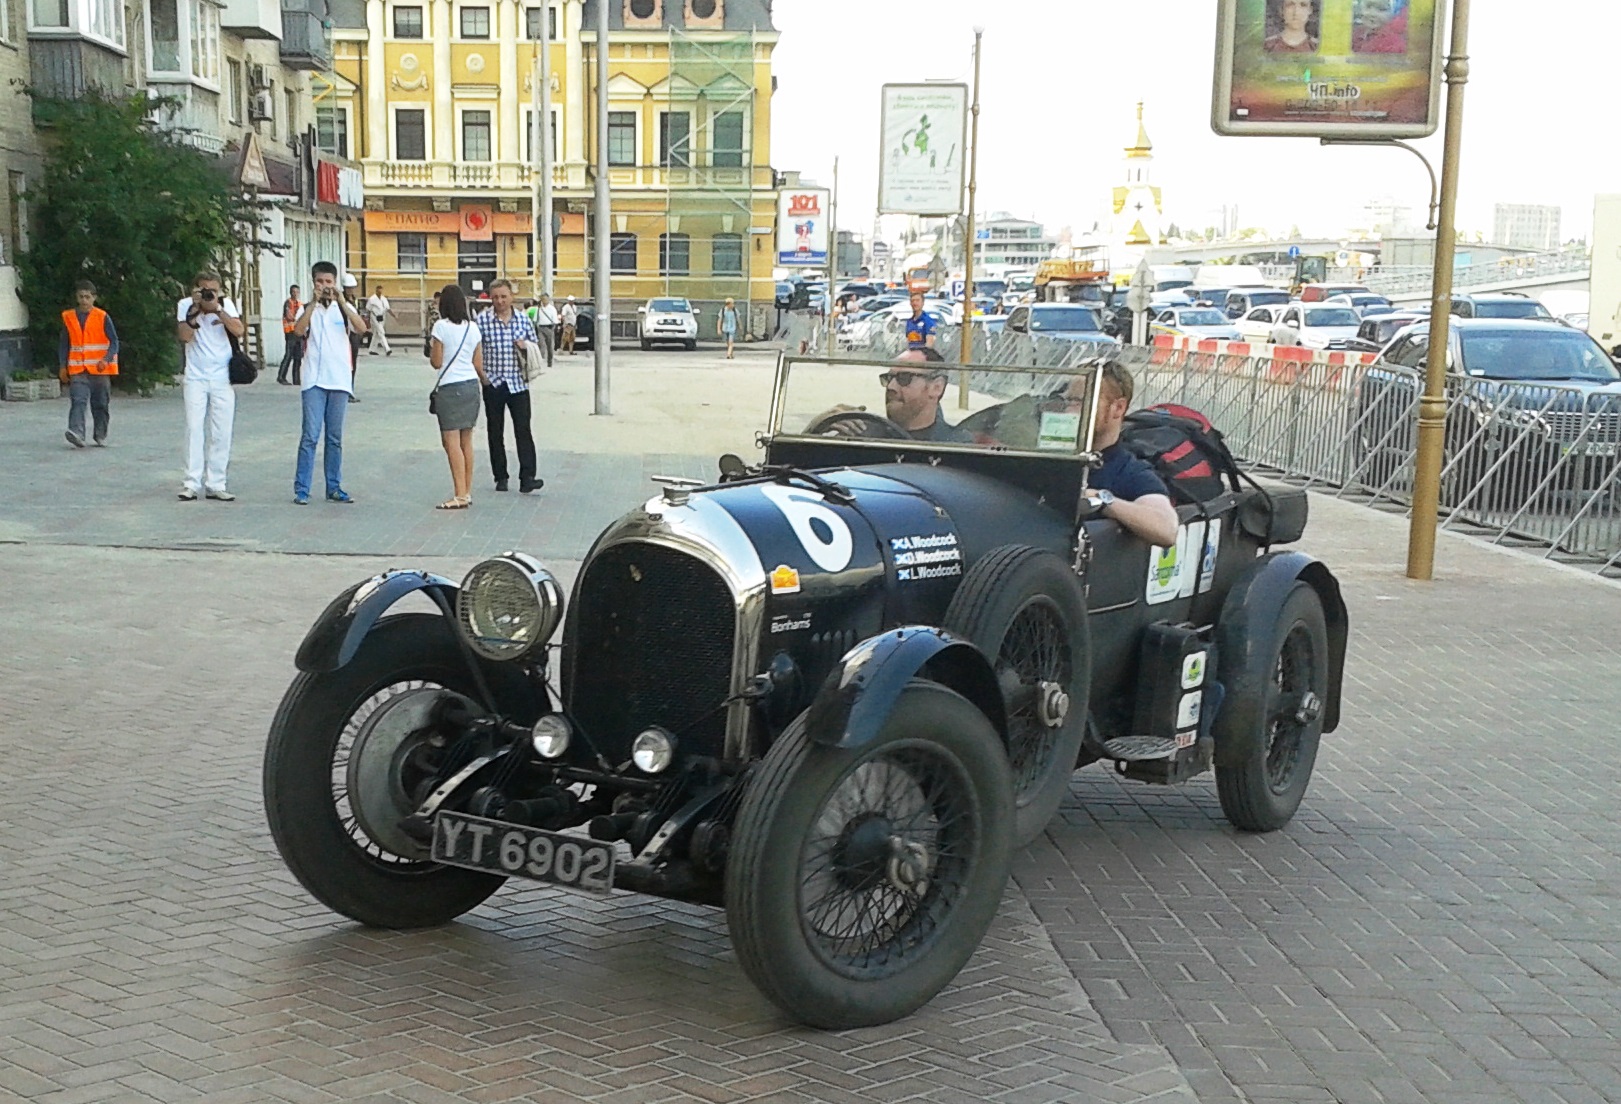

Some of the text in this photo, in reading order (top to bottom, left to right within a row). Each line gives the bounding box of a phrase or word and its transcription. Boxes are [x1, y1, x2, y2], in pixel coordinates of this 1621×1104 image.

[760, 484, 854, 573] 6
[771, 619, 811, 633] Bonhams
[441, 817, 608, 888] YT 6902
